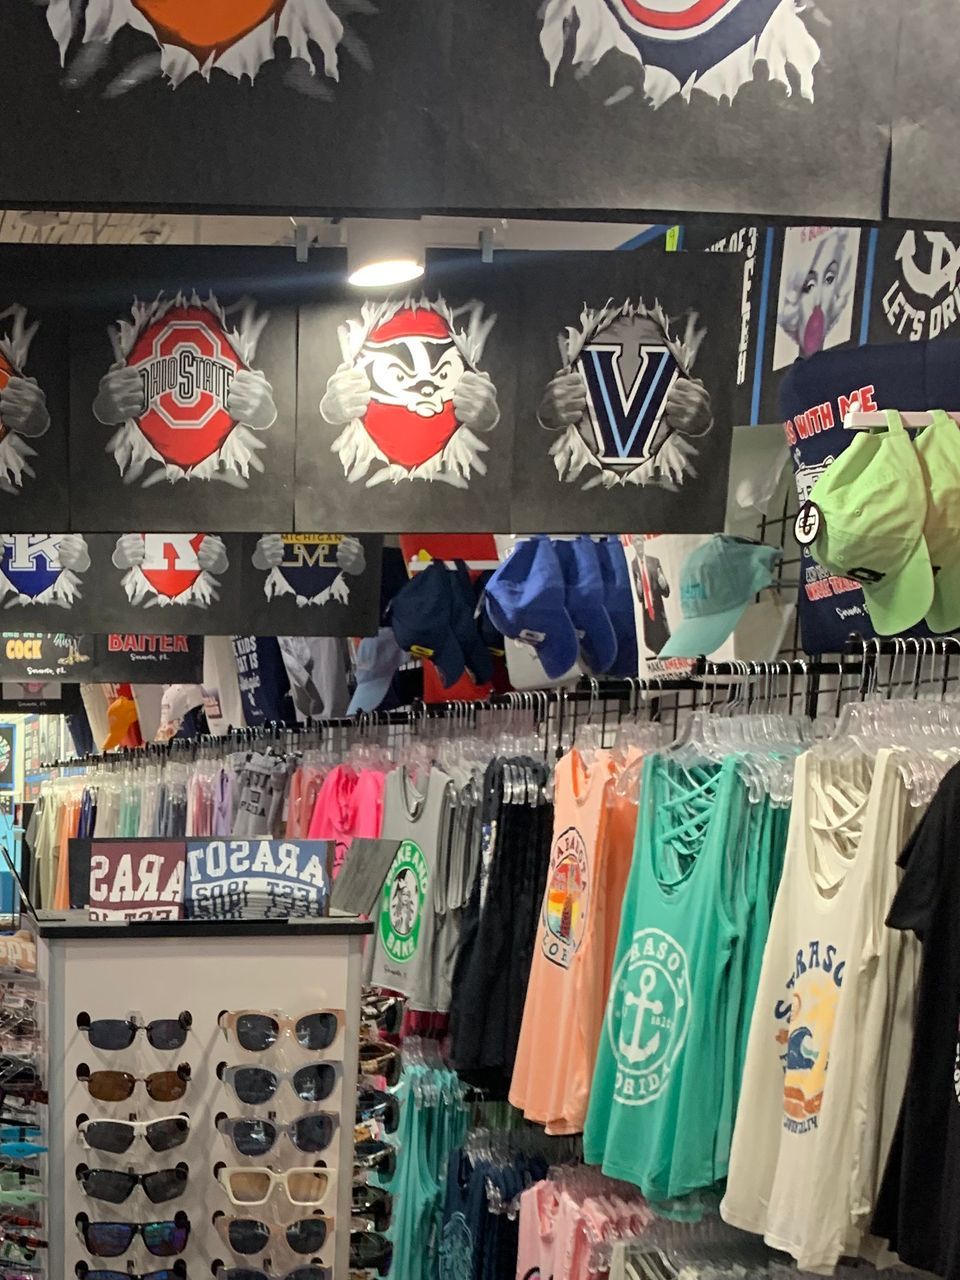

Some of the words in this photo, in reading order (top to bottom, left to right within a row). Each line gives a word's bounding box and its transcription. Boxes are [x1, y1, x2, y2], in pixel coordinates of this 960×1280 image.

[581, 344, 680, 463] V
[794, 402, 834, 440] WITH
[837, 384, 878, 423] ME
[5, 639, 42, 660] COCK
[386, 931, 416, 958] BAKE
